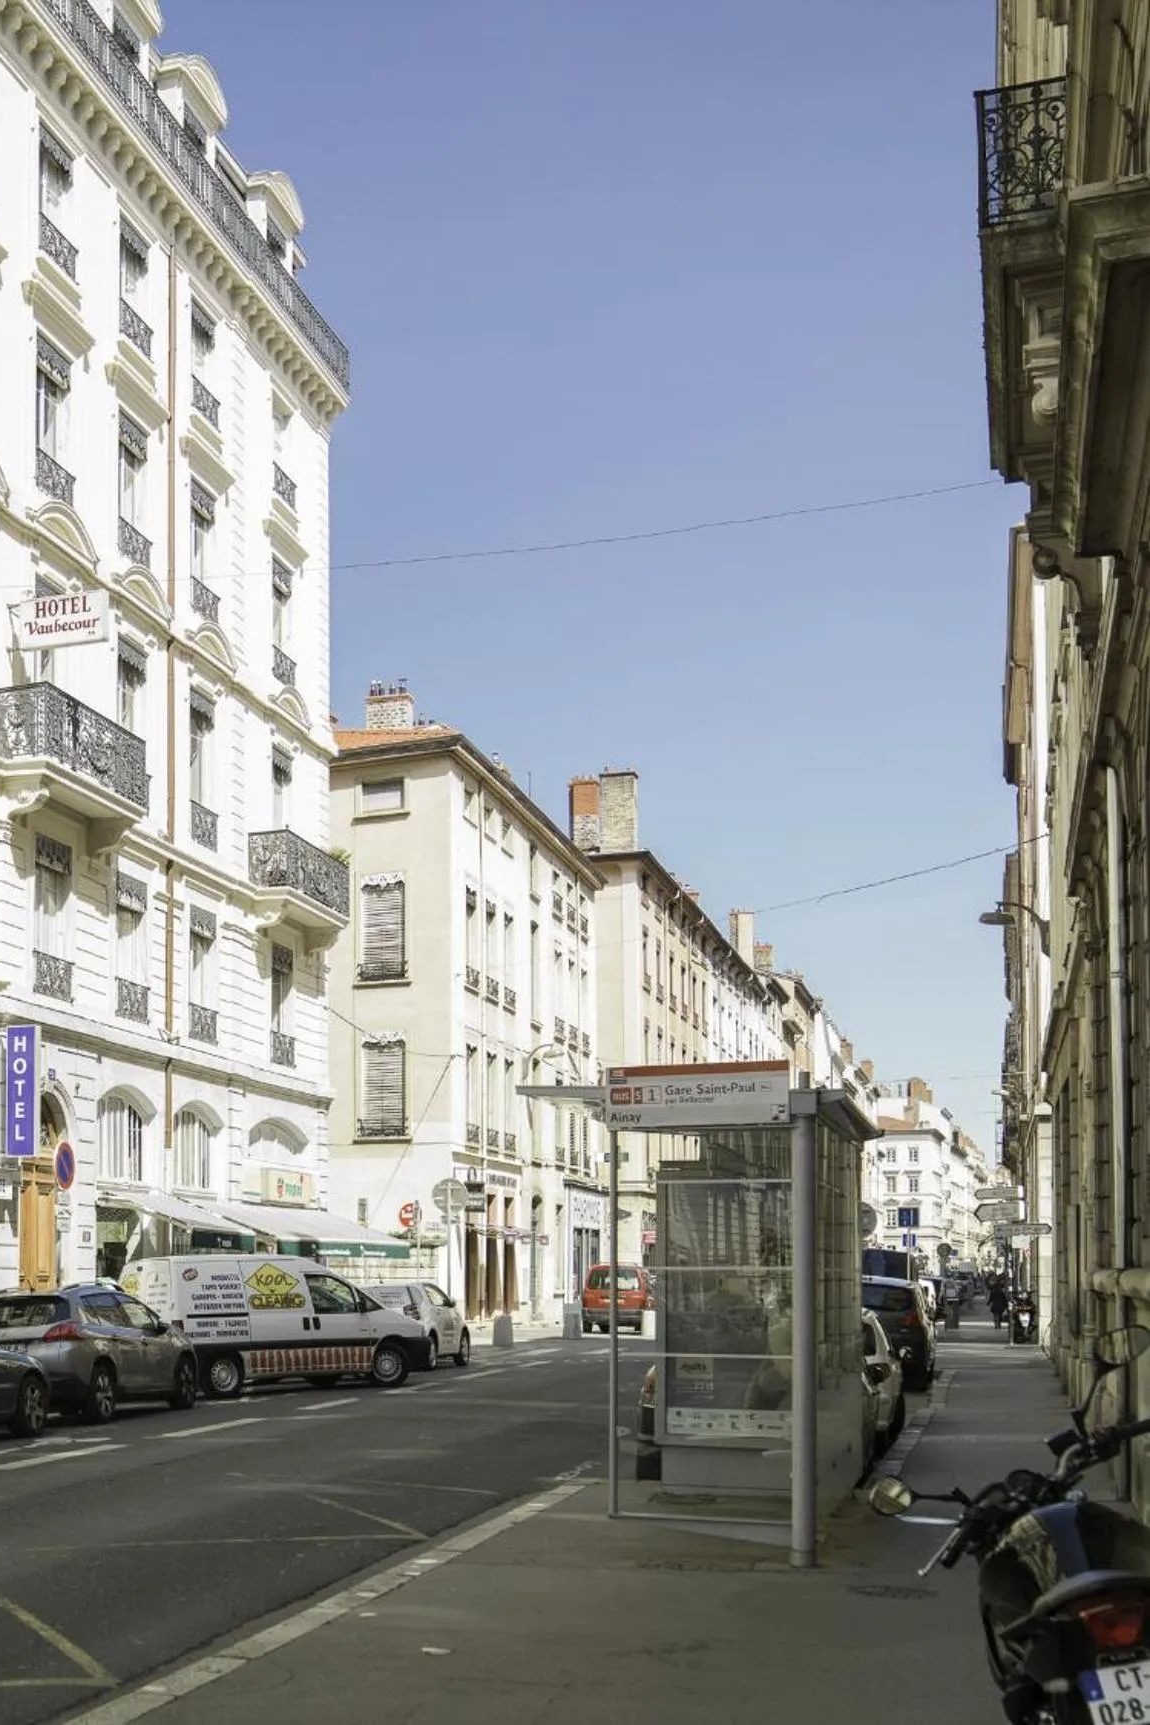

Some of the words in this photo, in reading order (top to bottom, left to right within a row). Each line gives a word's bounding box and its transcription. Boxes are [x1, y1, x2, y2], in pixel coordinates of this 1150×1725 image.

[34, 595, 91, 618] HOTEL
[24, 616, 101, 635] Vaubecour
[13, 1035, 28, 1141] HOTEL
[664, 1084, 692, 1096] Gare
[696, 1081, 756, 1095] Saint-Paul
[610, 1112, 642, 1124] Ainay
[255, 1274, 293, 1286] KOOL
